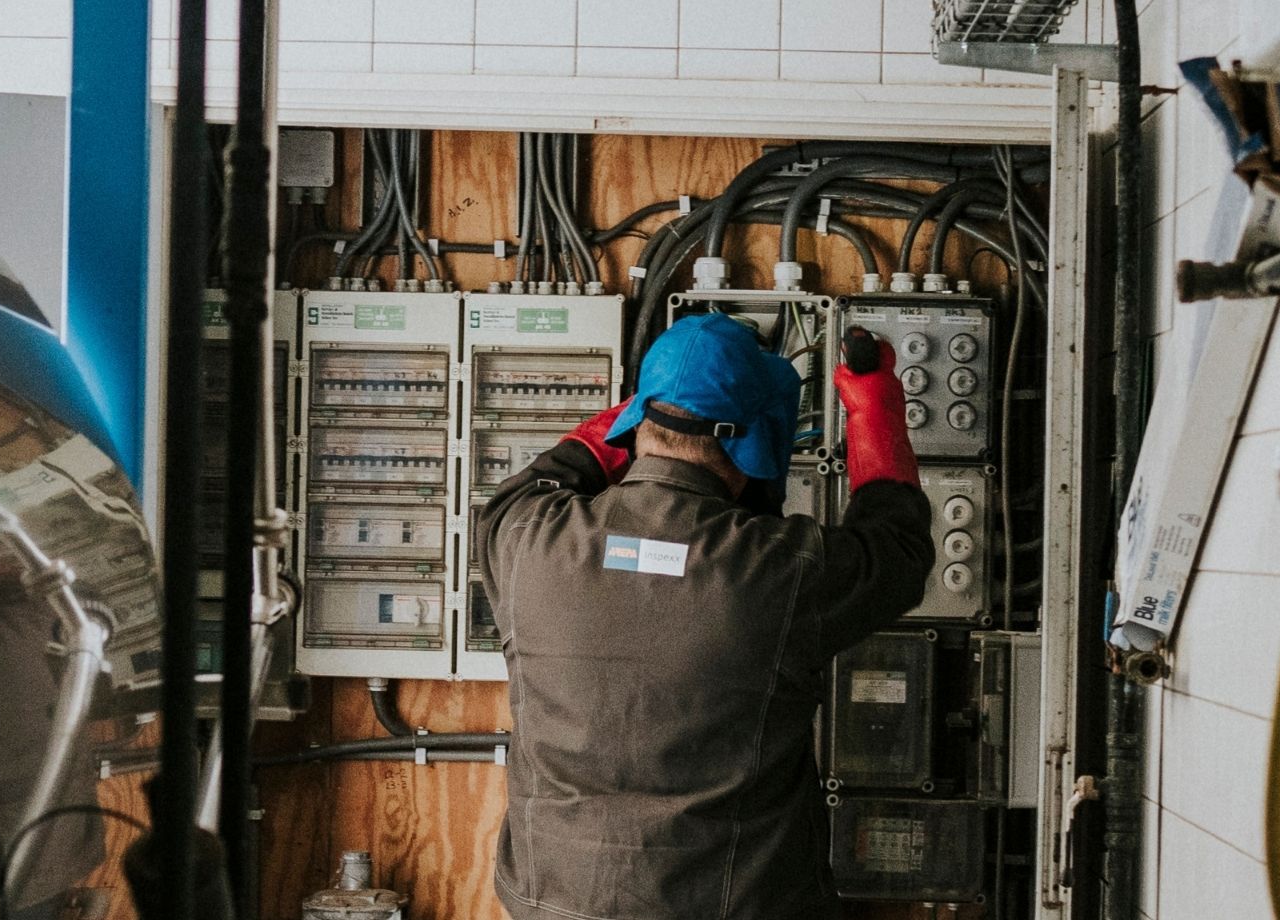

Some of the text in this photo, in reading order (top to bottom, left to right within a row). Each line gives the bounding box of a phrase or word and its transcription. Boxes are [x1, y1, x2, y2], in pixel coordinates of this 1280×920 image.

[1134, 596, 1159, 621] Blue
[1158, 590, 1177, 625] milk filters
